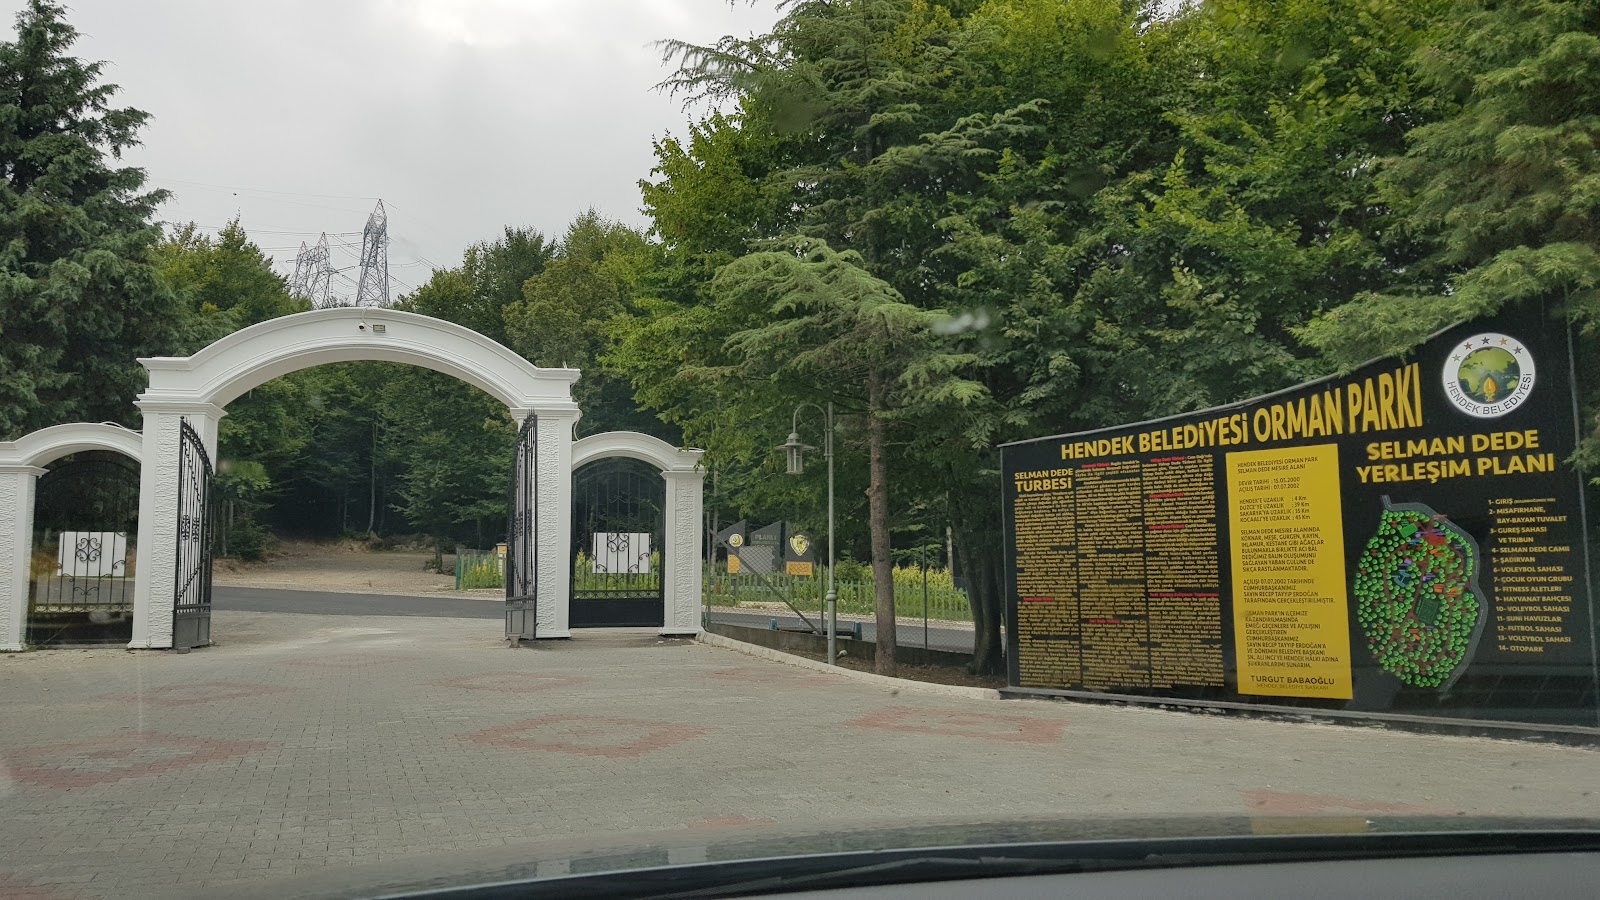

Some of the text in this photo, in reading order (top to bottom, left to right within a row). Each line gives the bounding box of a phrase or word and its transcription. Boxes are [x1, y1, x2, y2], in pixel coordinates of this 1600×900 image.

[1061, 362, 1423, 459] HENDEK BELEDİYESİ ORMAN PARKI
[1448, 381, 1481, 414] HENDEK
[1367, 430, 1539, 460] SELMAN DEDE
[1015, 470, 1049, 480] SELMAN
[1051, 468, 1073, 477] DEDE
[1356, 454, 1555, 484] YERLEŞİM PLANI
[1251, 675, 1335, 685] TURGUT BABAOĞLU
